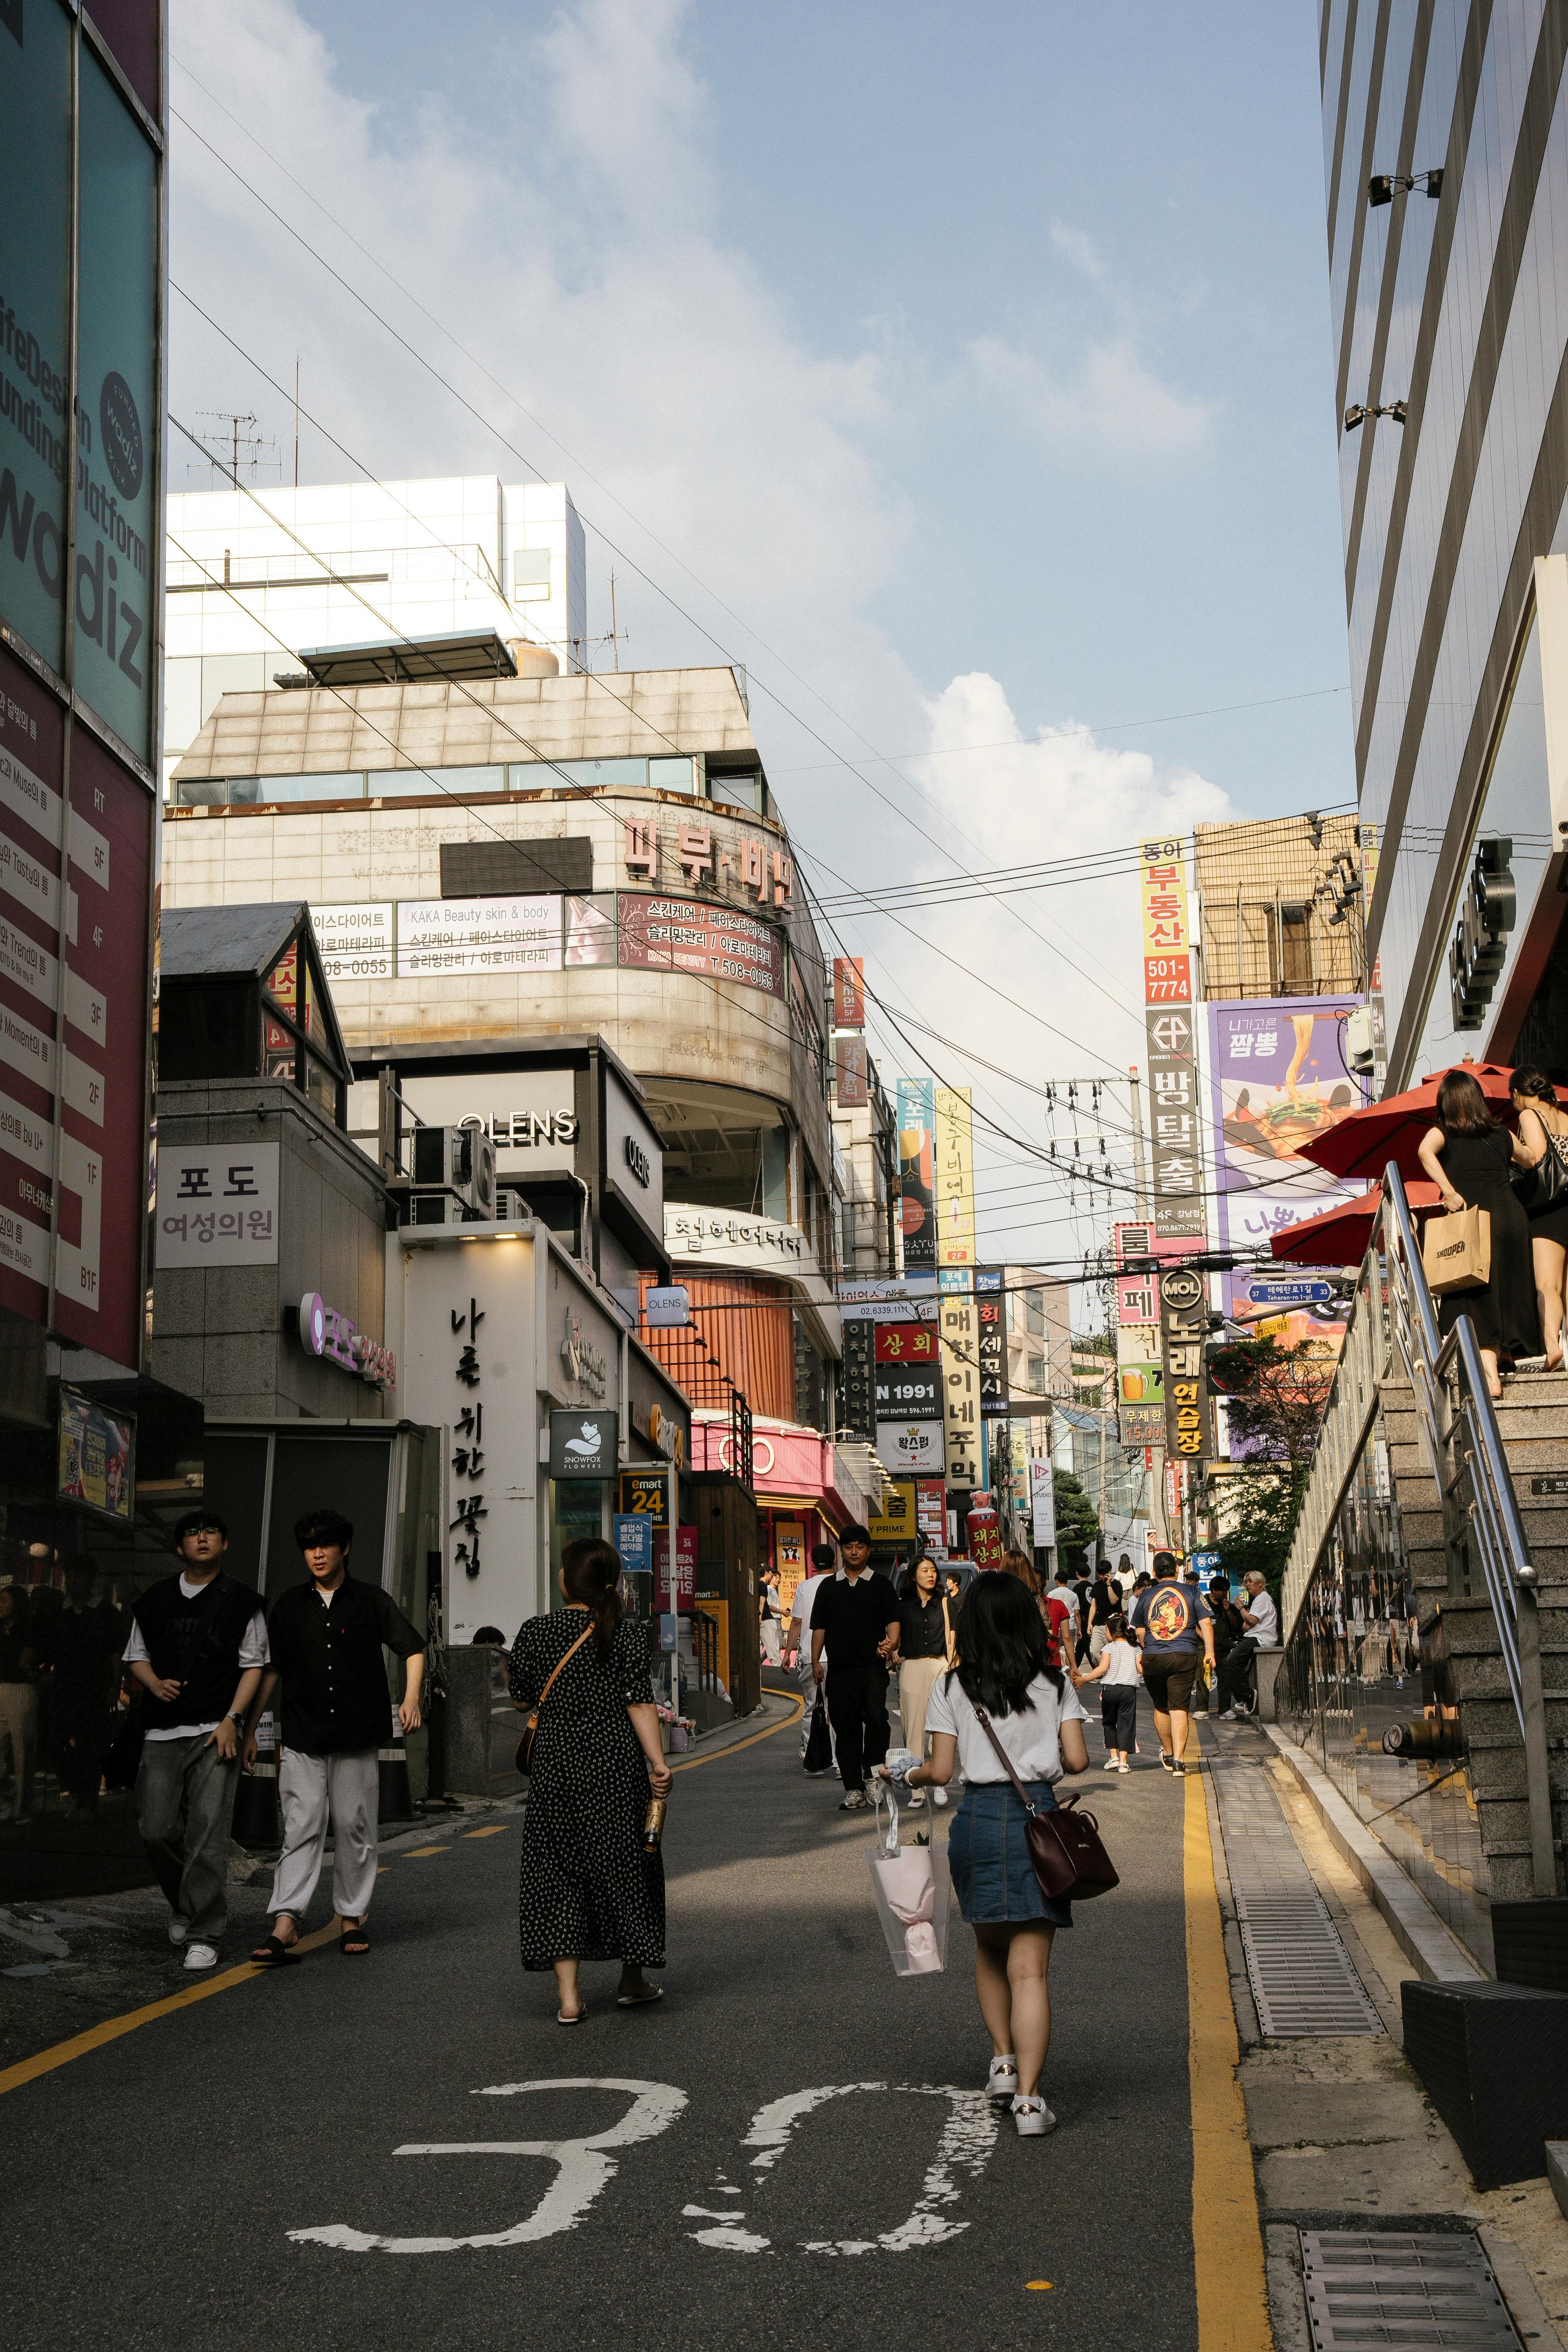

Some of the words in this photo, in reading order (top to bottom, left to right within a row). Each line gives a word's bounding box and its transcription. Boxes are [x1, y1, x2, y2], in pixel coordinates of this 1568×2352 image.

[114, 385, 139, 447] FUNDED
[108, 399, 137, 478] wadiz
[107, 443, 125, 487] WITH
[8, 698, 28, 732] 달빛의
[30, 719, 36, 740] 틈
[13, 766, 38, 800] Muse의
[40, 790, 47, 811] 틈
[94, 788, 105, 813] RT
[95, 846, 104, 869] 5F
[1143, 841, 1183, 861] 동아
[13, 851, 39, 889] Tasty의
[42, 875, 47, 896] 틈
[411, 909, 440, 923] KAKA
[445, 908, 481, 923] Beauty
[485, 906, 507, 920] skin
[511, 905, 519, 918] &
[524, 904, 549, 920] body
[1146, 866, 1184, 947] 부동산
[311, 913, 384, 929] 이스다이어트
[647, 901, 695, 920] 스킨케어
[708, 911, 770, 943] 페이스다이어트
[93, 926, 102, 948] 4F
[410, 932, 453, 947] 스킨케어
[469, 928, 548, 944] 페이스다이어트
[647, 925, 707, 947] 슬리밍관리
[720, 936, 771, 966] 아로마테라피
[10, 933, 37, 970] Trend의
[39, 955, 45, 976] 틈
[410, 953, 464, 968] 슬리밍관리
[481, 949, 549, 965] 아로마테라피
[648, 950, 671, 964] KAKA
[673, 952, 705, 968] BEAUTY
[325, 960, 386, 975] 08-0055
[1148, 980, 1188, 998] 7774
[91, 1002, 101, 1025] 3F
[1229, 1017, 1277, 1031] 니가고른
[5, 1016, 39, 1057] Moment의
[42, 1042, 47, 1062] 틈
[1229, 1032, 1278, 1058] 짬뽕
[89, 1082, 99, 1105] 2F
[0, 1108, 21, 1140] 상의틈
[24, 1124, 32, 1147] by
[35, 1131, 43, 1150] U+
[457, 1108, 575, 1140] OLENS
[627, 1135, 650, 1188] OLENS
[87, 1163, 96, 1185] 1F
[177, 1166, 258, 1198] 포도
[1157, 1210, 1171, 1219] 4F
[1178, 1210, 1199, 1218] 강남점
[16, 1224, 22, 1244] 틈
[162, 1210, 273, 1243] 여성의원
[664, 1216, 800, 1257] 철헤어커커
[15, 1249, 32, 1268] 전시공간
[1436, 1240, 1465, 1258] SHOOPEN
[81, 1266, 96, 1292] B1F
[946, 1272, 962, 1281] 포레
[1121, 1229, 1152, 1316] 룸페
[1165, 1282, 1198, 1296] MOL
[649, 1298, 681, 1309] OLENS
[861, 1306, 908, 1314] 02.6339.1111
[921, 1308, 933, 1316] 4F
[1256, 1328, 1263, 1337] 방범
[1264, 1326, 1276, 1334] CCTV
[894, 1385, 934, 1399] 1991
[1126, 1410, 1162, 1423] 무제한
[898, 1436, 928, 1450] 왕스펍
[632, 1480, 662, 1489] emart
[632, 1490, 664, 1513] 24
[620, 1524, 643, 1532] 졸업식
[620, 1534, 643, 1542] 꽃다발
[973, 1527, 999, 1545] 돼지
[620, 1543, 643, 1551] 예약중
[975, 1546, 1001, 1563] 상회
[660, 1554, 693, 1564] 이트24
[285, 2077, 999, 2256] 30
